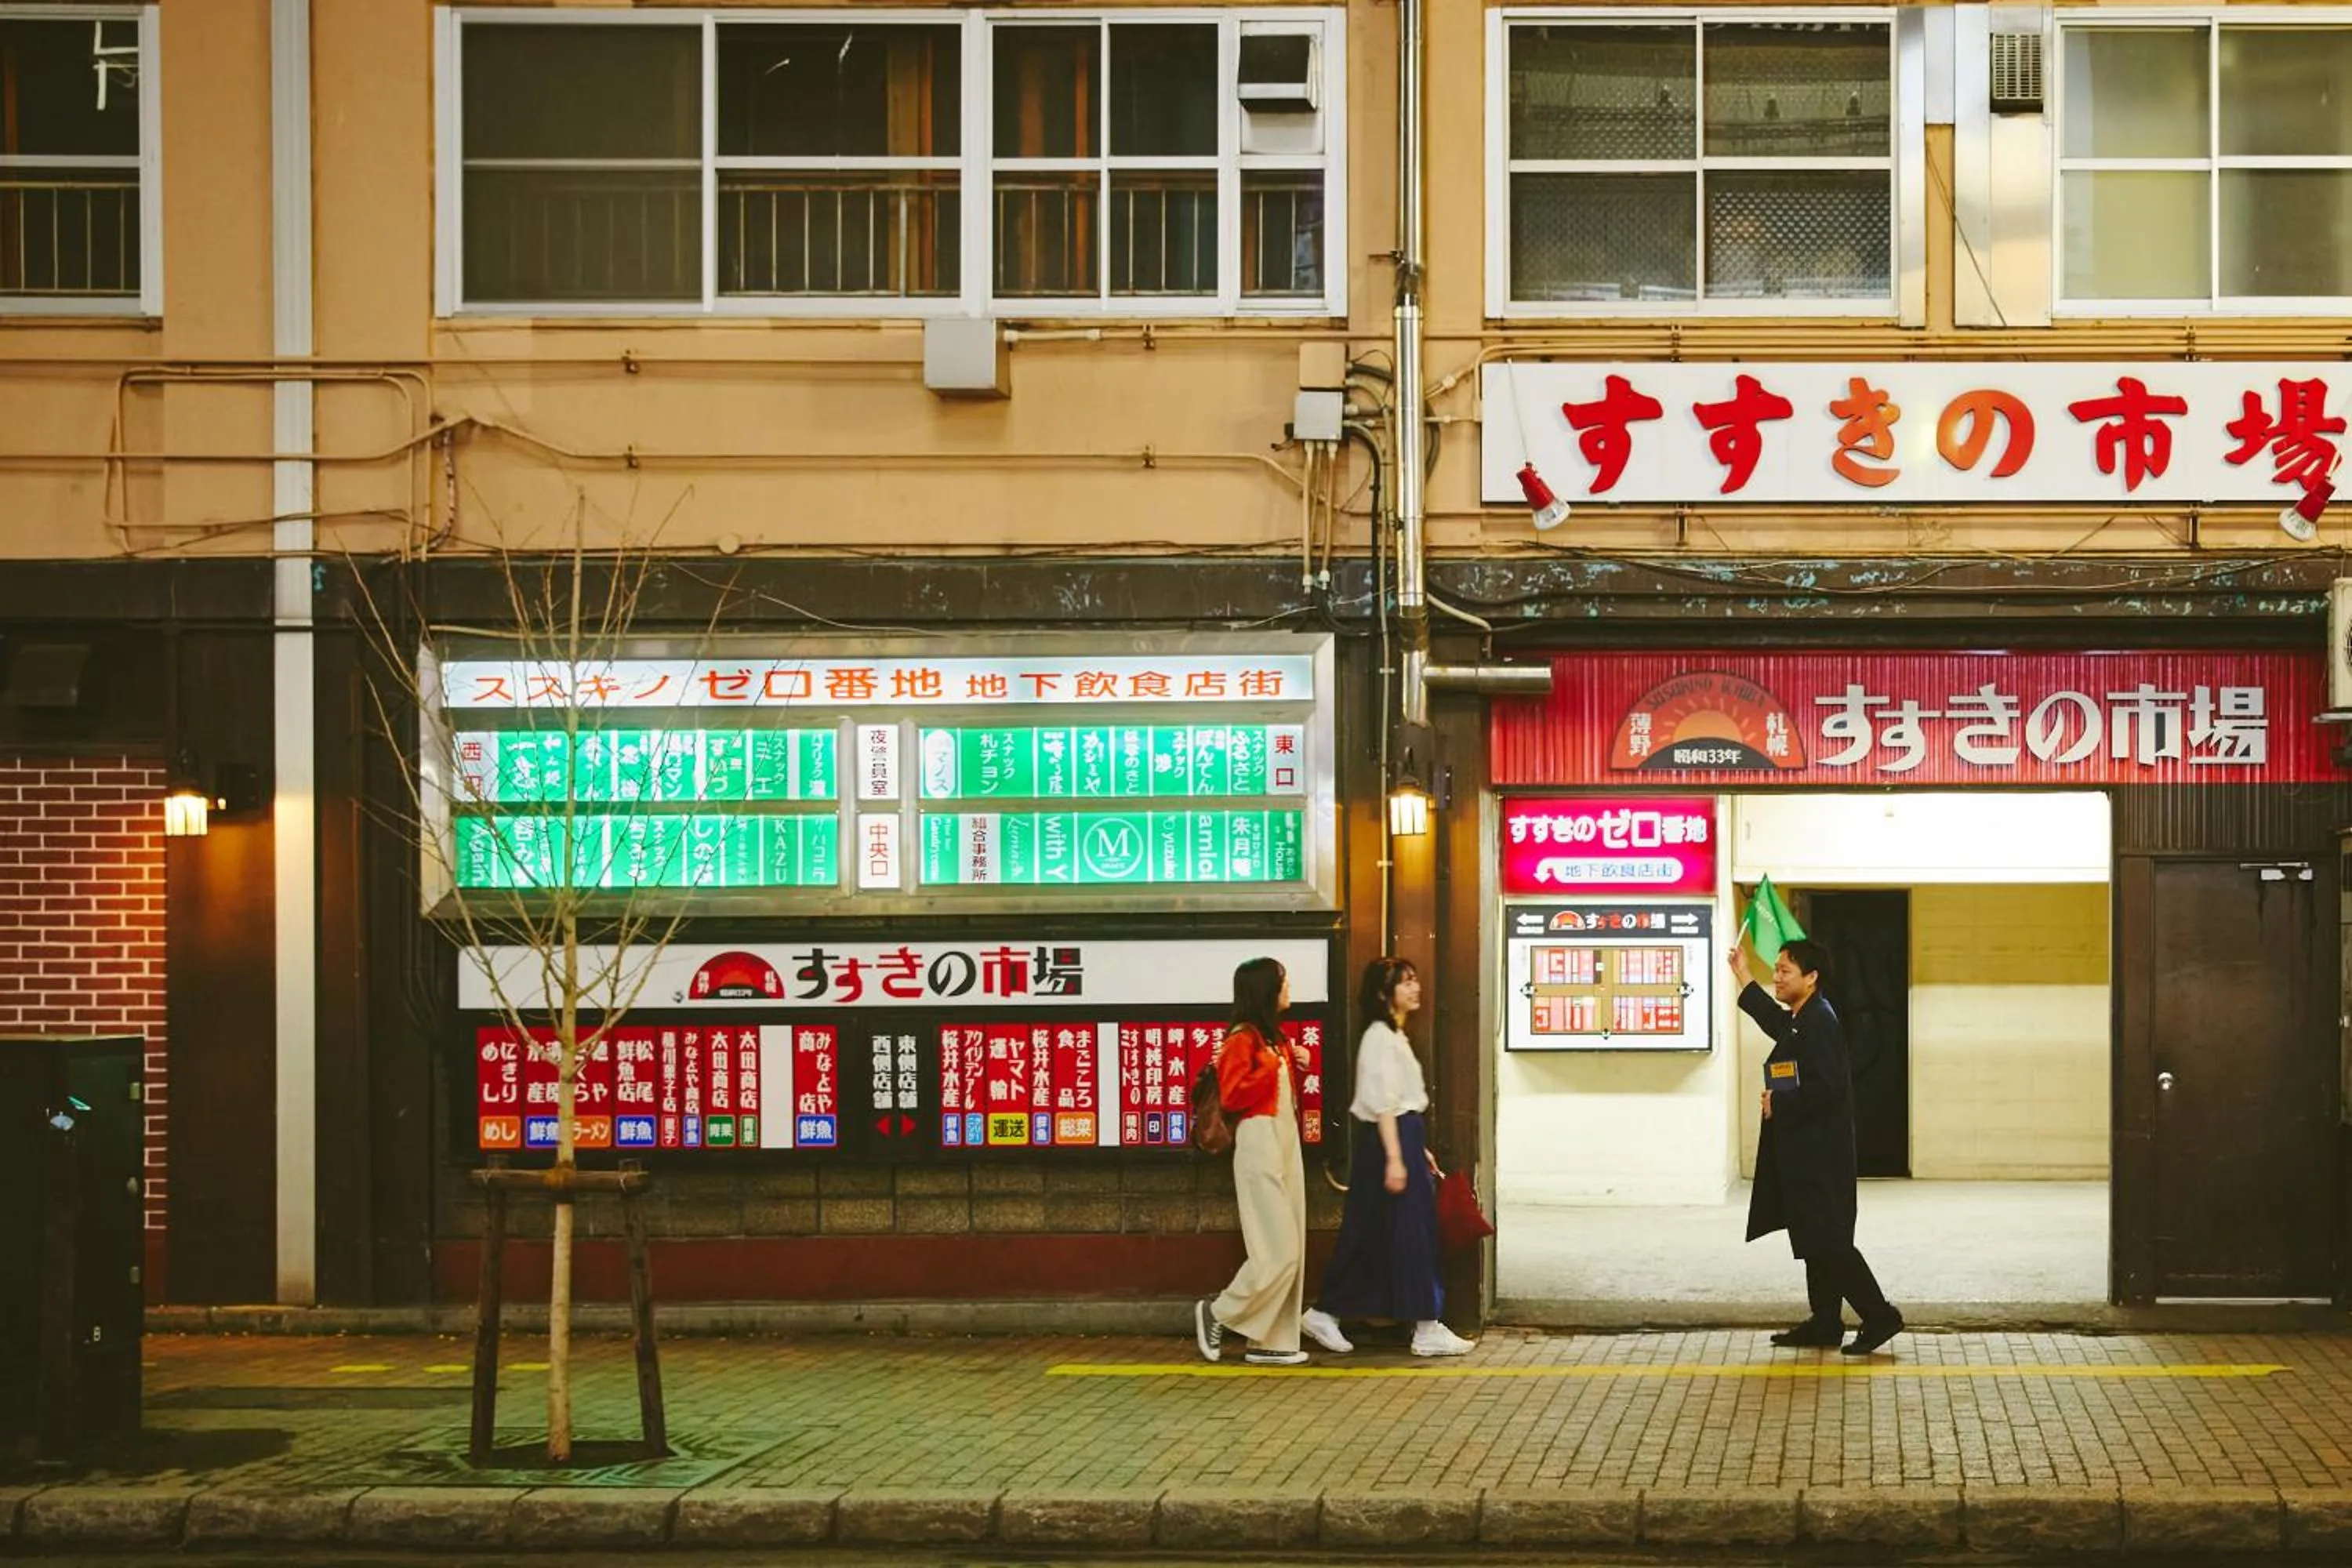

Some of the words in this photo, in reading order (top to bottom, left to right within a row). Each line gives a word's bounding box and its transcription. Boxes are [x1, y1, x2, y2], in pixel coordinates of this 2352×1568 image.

[1561, 374, 2347, 494] すすきの市場
[1003, 732, 1015, 779] スナック
[1173, 731, 1186, 778] スナック
[1252, 731, 1265, 777] スナック
[1673, 749, 1742, 764] 昭和33年
[1814, 682, 2269, 772] すすきの市場
[1275, 735, 1294, 786] 東口
[774, 818, 787, 883] KAZU
[869, 822, 888, 876] 中央口
[1045, 815, 1067, 860] with
[1096, 827, 1131, 857] M
[1508, 808, 1708, 849] すすきのゼロ番地
[792, 946, 1084, 1004] すすきの市場
[481, 1041, 499, 1103] めし
[500, 1041, 517, 1103] にぎり
[617, 1040, 636, 1103] 鮮魚店
[711, 1030, 729, 1109] 太田商店
[739, 1030, 758, 1110] 太田商店
[798, 1030, 816, 1113] 商店
[815, 1032, 833, 1113] みなとや
[872, 1035, 893, 1109] 西側店舗
[898, 1034, 918, 1109] 東側店舗
[942, 1029, 960, 1108] 桜井水産
[1007, 1037, 1025, 1101] ヤマト
[1032, 1028, 1050, 1106] 桜井水産
[1057, 1028, 1075, 1109] 食品
[484, 1121, 517, 1141] めし
[619, 1120, 652, 1141] 鮮魚
[800, 1120, 833, 1140] 鮮魚
[993, 1118, 1025, 1138] 運送
[1149, 1120, 1160, 1133] 印
